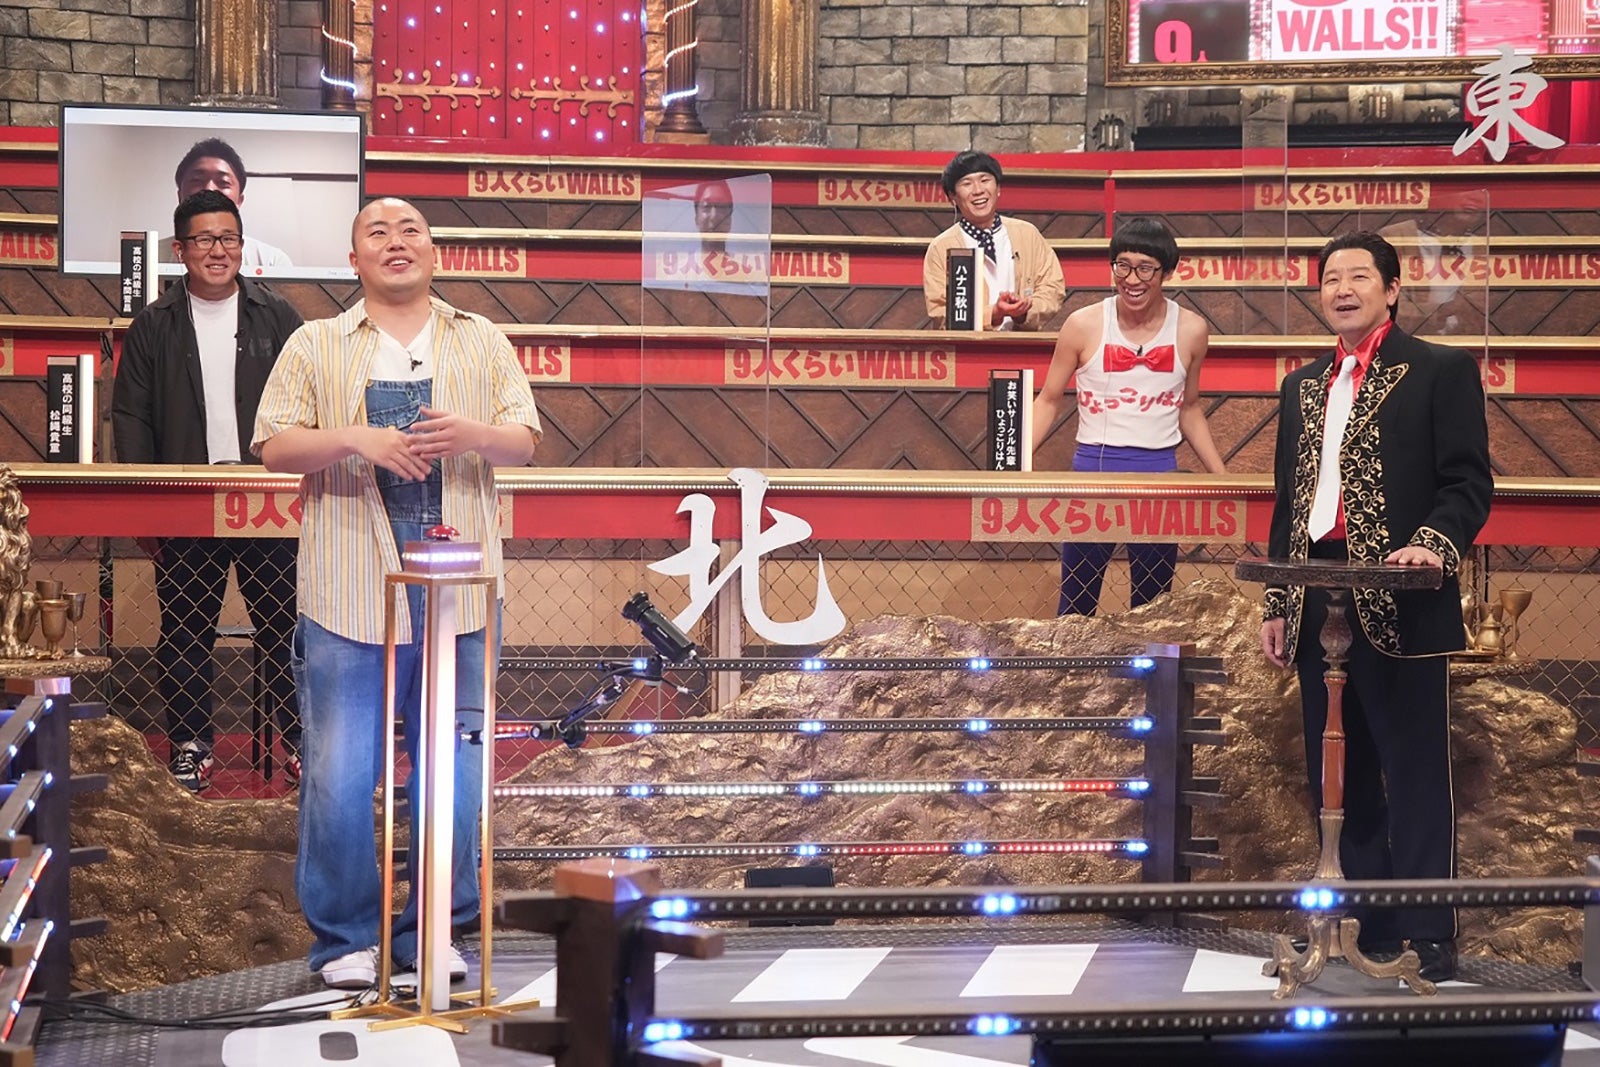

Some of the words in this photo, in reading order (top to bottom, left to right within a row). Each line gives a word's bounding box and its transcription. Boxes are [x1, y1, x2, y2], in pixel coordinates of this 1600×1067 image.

[1277, 6, 1438, 52] WALLS!!
[1452, 44, 1566, 162] 東
[474, 169, 635, 196] 9人くらいWALLS
[1261, 181, 1424, 206] 9人くらいWALLS
[132, 246, 142, 297] 高校の同級生
[662, 251, 843, 278] 9人くらいWALLS
[955, 265, 968, 322] ハナコ秋山
[733, 349, 948, 380] 9人くらいWALLS
[61, 373, 73, 436] 高校の同級生
[1005, 380, 1017, 466] お笑いサークル先輩
[995, 409, 1006, 471] ひょっこりはん
[981, 497, 1237, 536] 9人くらいWALLS
[646, 467, 847, 645] 北
